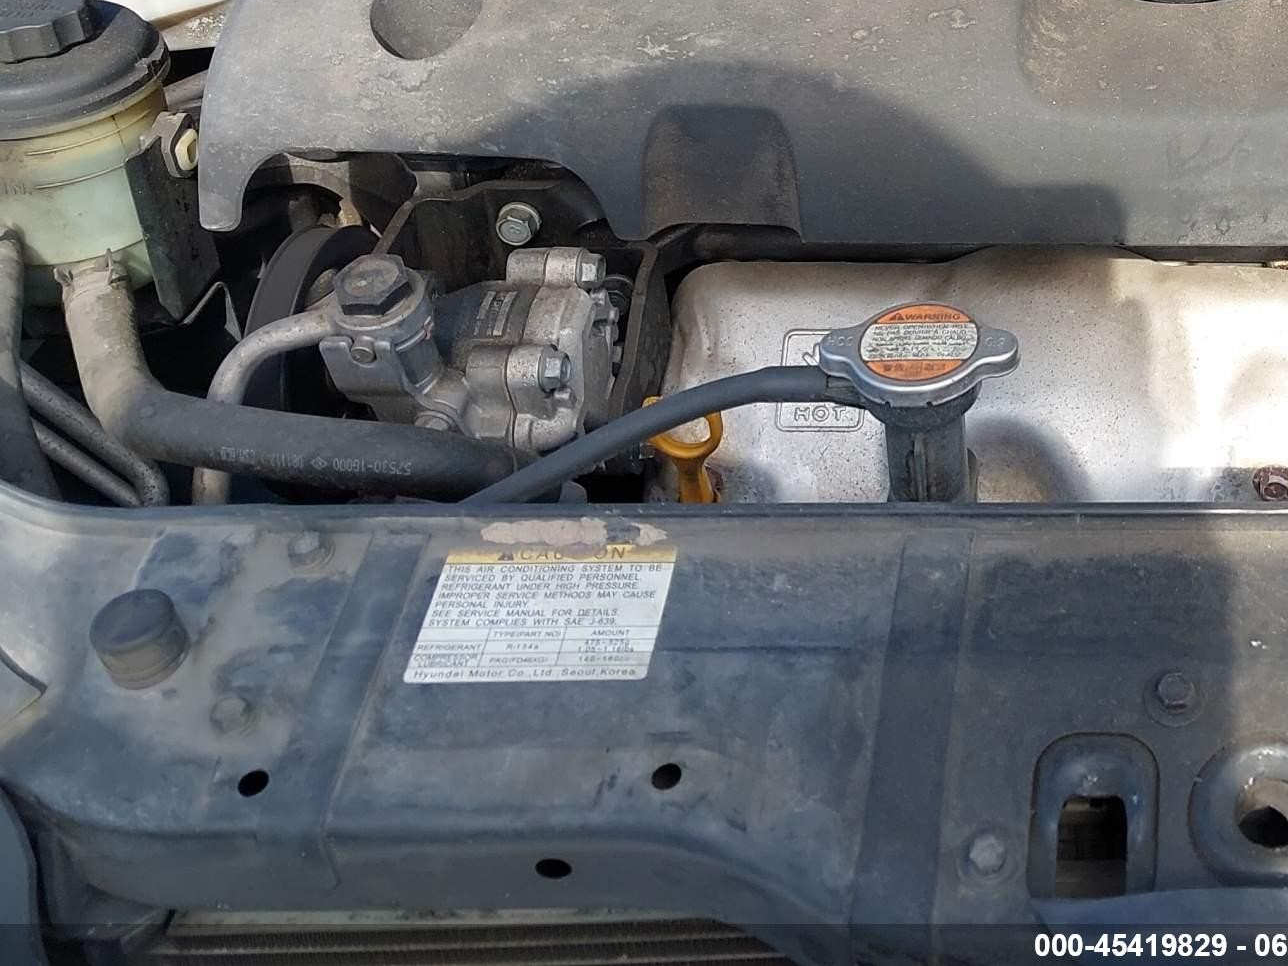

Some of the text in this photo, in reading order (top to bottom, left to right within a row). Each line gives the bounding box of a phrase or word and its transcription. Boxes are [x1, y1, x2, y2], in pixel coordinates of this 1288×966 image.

[906, 313, 961, 321] WARNING
[795, 405, 846, 422] HOT
[520, 546, 625, 561] CAUON
[448, 565, 472, 573] THIS
[477, 565, 495, 573] AIR
[500, 564, 575, 573] CONDITIONING
[581, 564, 623, 572] SYSTEM
[629, 564, 643, 572] TO
[444, 574, 496, 582] SERVICED
[501, 574, 514, 582] BY
[520, 573, 574, 582] QUALIFIED
[441, 583, 512, 591] REFRIGERANT
[516, 583, 550, 591] UNDER
[556, 582, 580, 590] HIGH
[438, 590, 656, 600] IMPROPER SERVICE METHODS MAY CAUSE
[434, 601, 487, 609] PERSONAL
[505, 609, 545, 617] MANUAL
[428, 618, 471, 627] SYSTEM
[475, 618, 528, 626] COMPLIES
[533, 618, 559, 626] WITH
[414, 670, 465, 679] Hyundai
[469, 669, 503, 677] Motor
